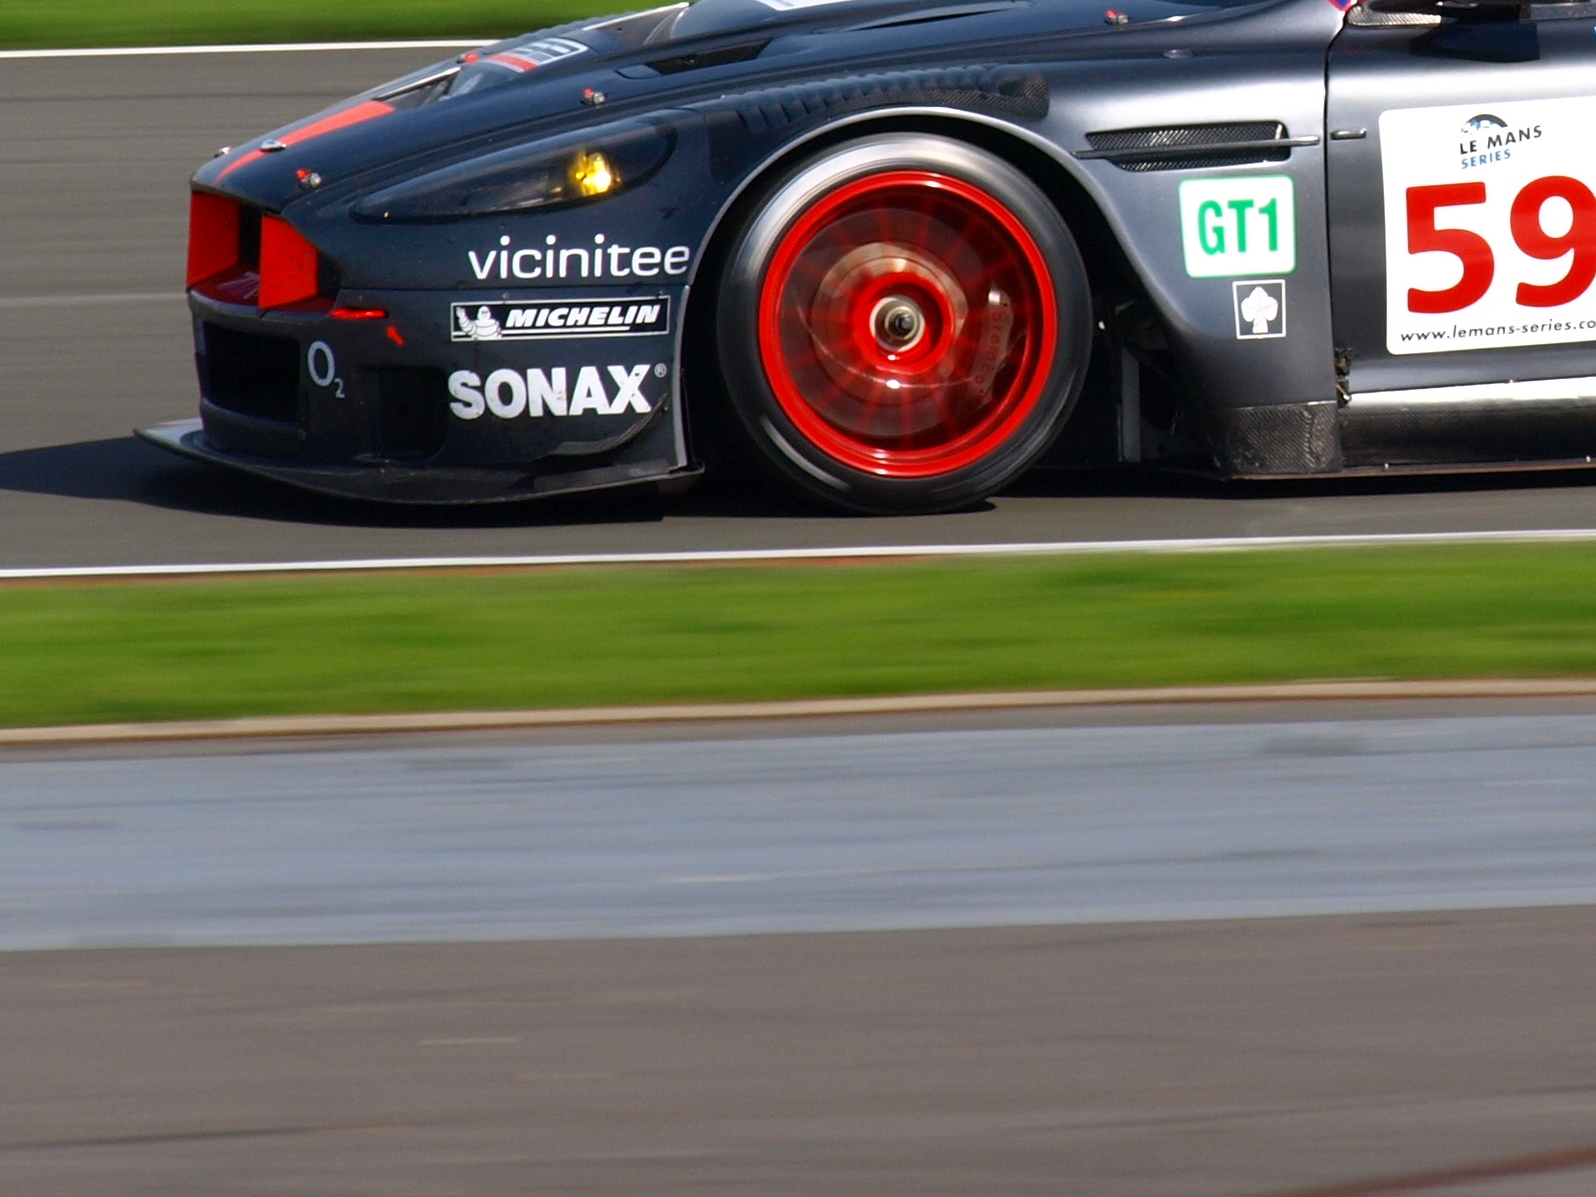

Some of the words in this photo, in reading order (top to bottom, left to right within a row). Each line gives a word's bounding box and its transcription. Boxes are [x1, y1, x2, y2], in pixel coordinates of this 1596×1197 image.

[1459, 139, 1478, 155] LE
[1487, 124, 1543, 150] MANS
[1460, 148, 1512, 170] SERIES
[1196, 197, 1280, 256] GT1
[467, 233, 691, 280] vicinitee
[505, 304, 661, 329] MICHELIN
